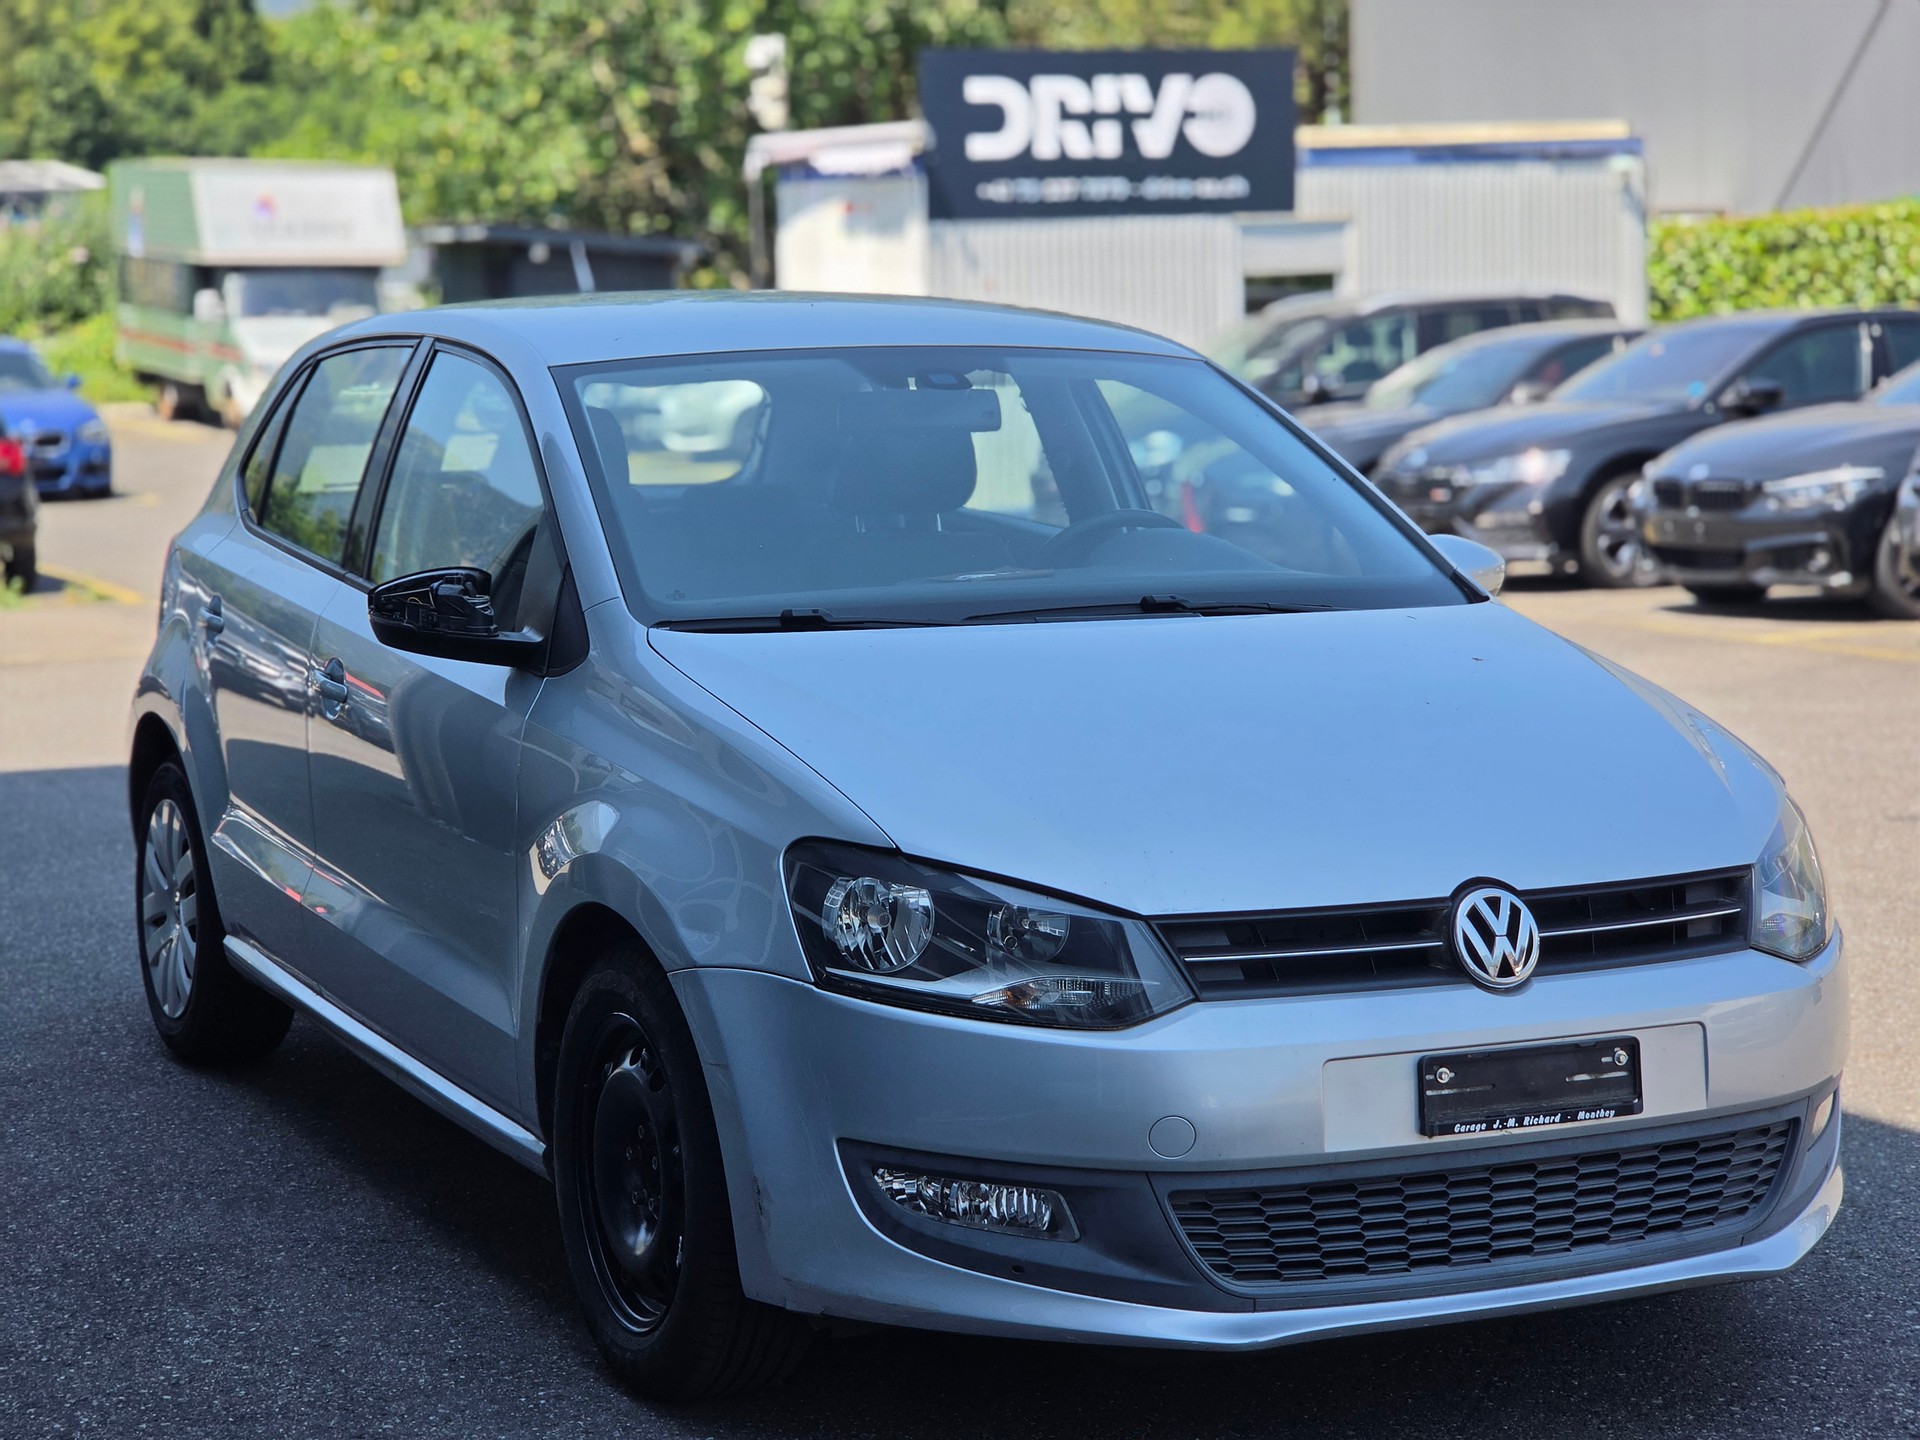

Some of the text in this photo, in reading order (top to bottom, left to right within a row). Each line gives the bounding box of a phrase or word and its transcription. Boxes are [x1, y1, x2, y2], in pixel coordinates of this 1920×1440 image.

[1456, 887, 1539, 984] VW
[1454, 1122, 1487, 1133] Garage
[1493, 1119, 1519, 1129] J.-M.
[1523, 1113, 1561, 1126] Richard
[1577, 1108, 1616, 1120] Monthey
